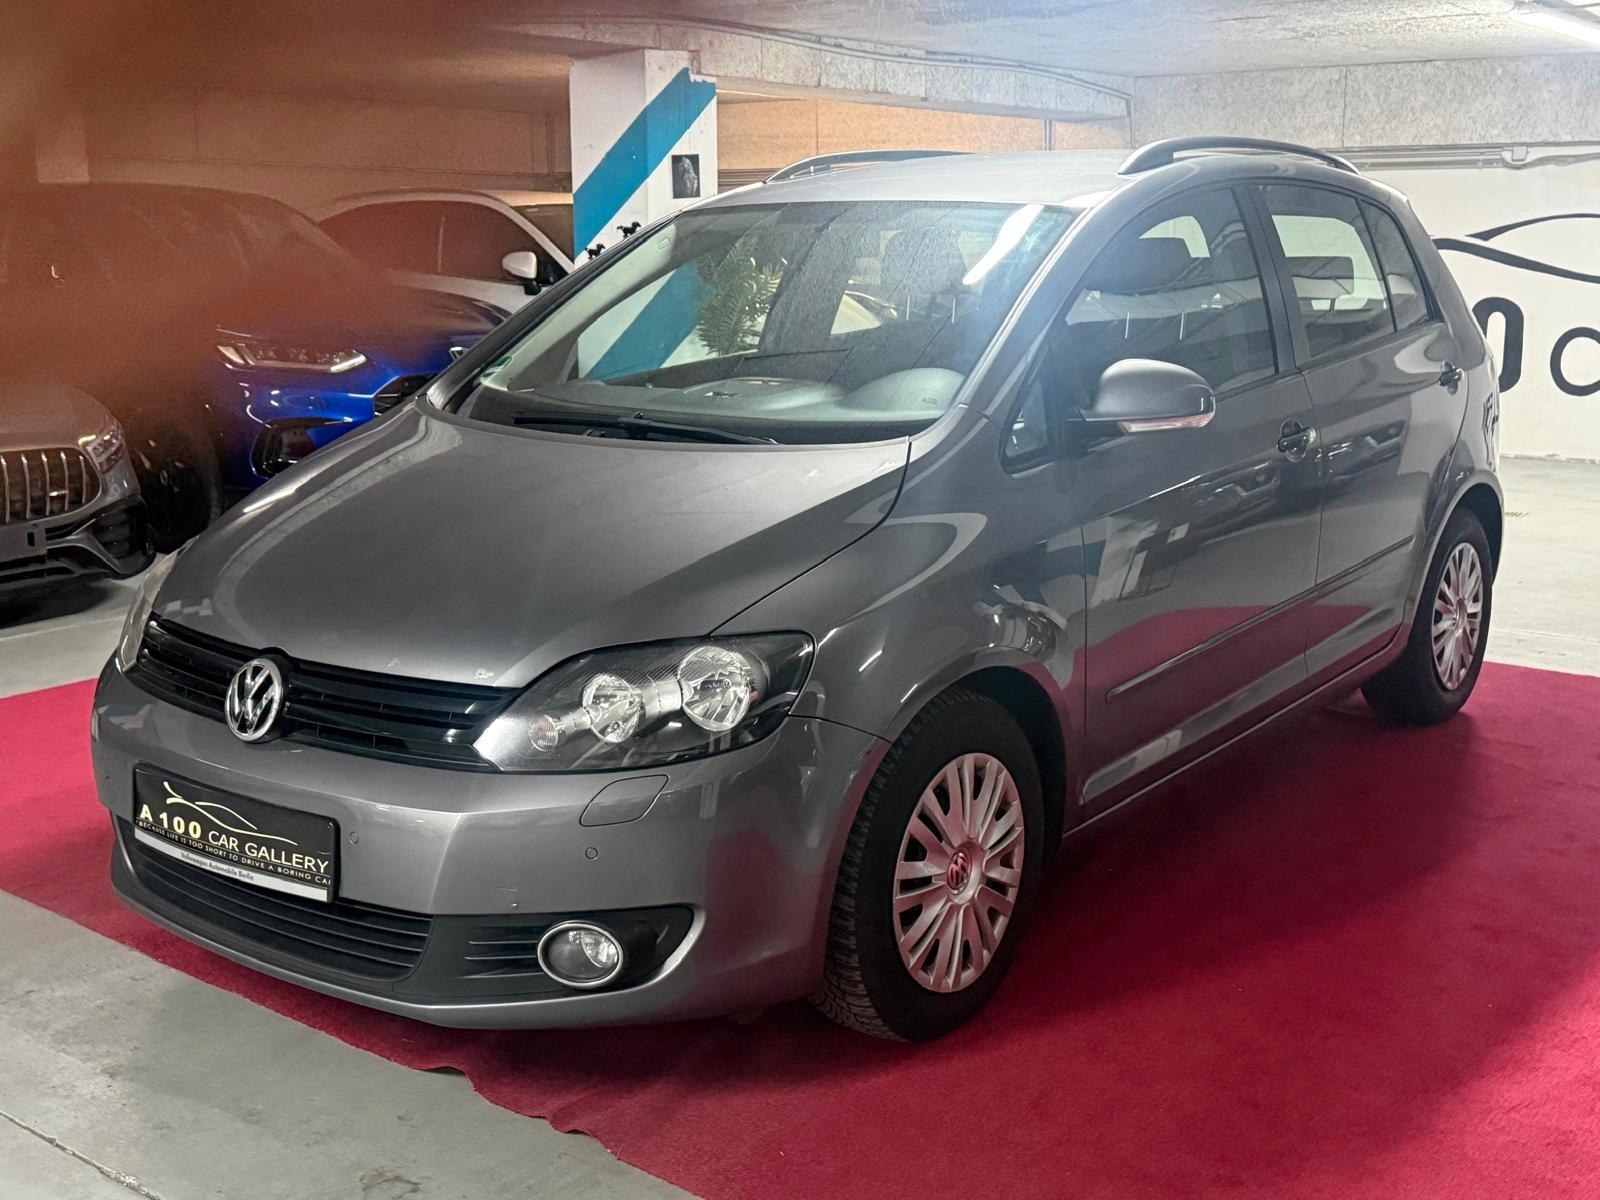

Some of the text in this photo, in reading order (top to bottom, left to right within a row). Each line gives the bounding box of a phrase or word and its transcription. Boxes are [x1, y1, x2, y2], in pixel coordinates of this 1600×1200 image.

[139, 821, 165, 836] BECAUSE
[166, 832, 178, 842] LIFE
[189, 839, 203, 849] TOO
[205, 845, 227, 858] SHORT
[229, 852, 239, 861] TO
[241, 856, 265, 869] DRIVE
[277, 866, 312, 880] BORING
[140, 804, 329, 874] A 100 CAR GALLERY
